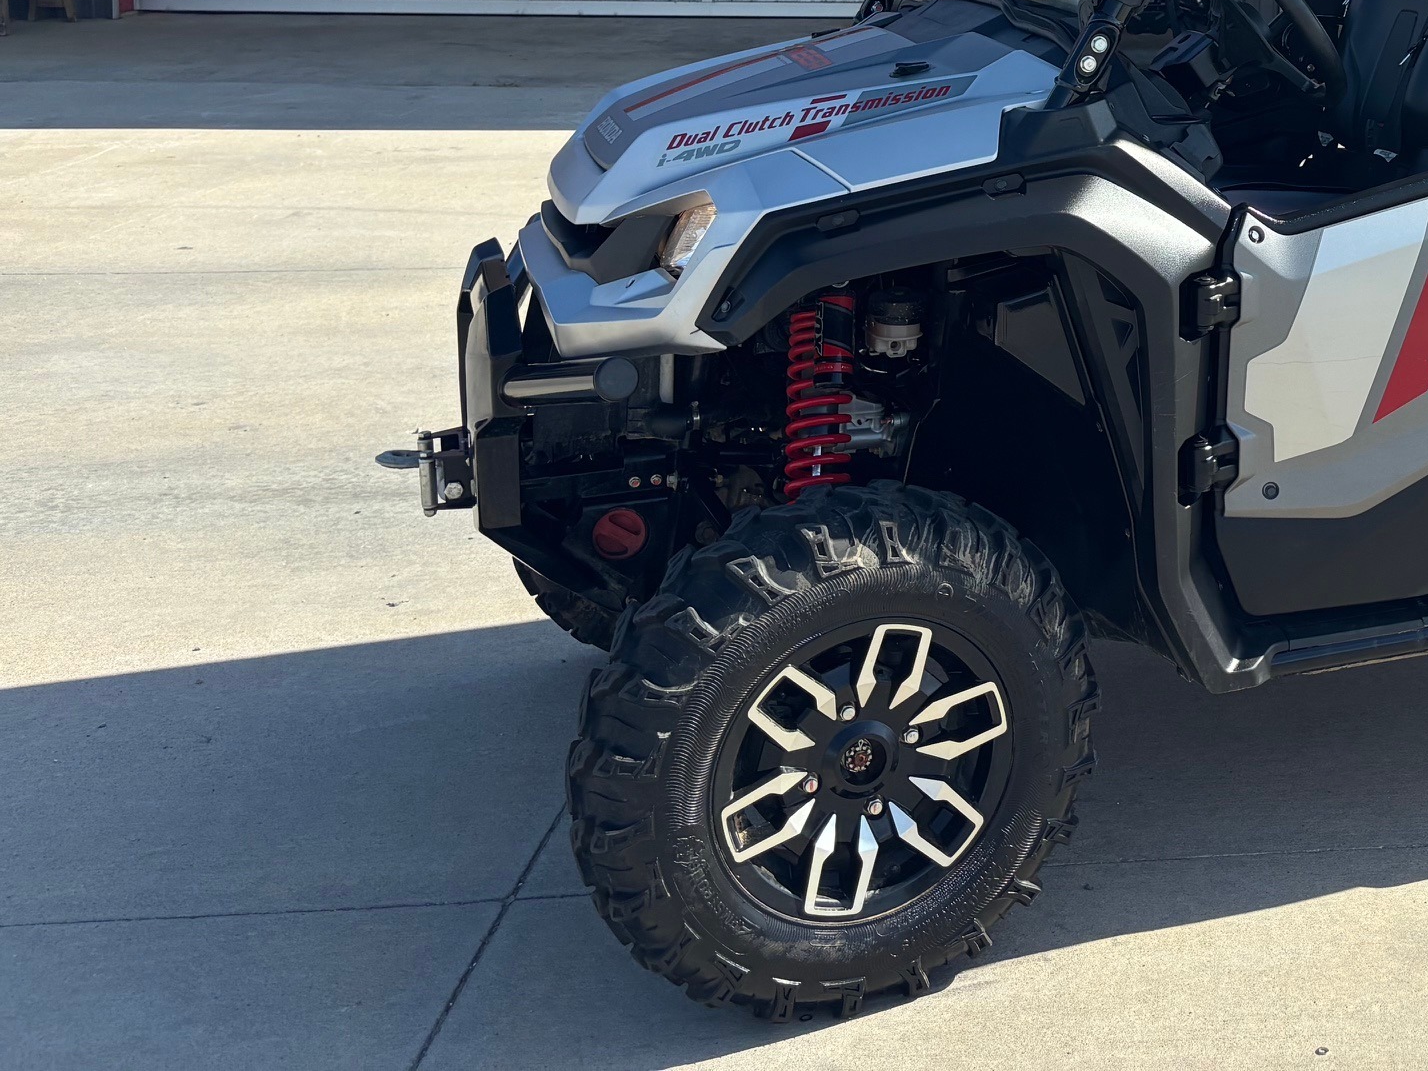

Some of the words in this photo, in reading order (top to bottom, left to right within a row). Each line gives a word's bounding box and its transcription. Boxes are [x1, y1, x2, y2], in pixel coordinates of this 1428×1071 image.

[666, 126, 721, 150] Dual
[722, 111, 795, 139] Clutch
[799, 85, 952, 124] Transmission
[656, 139, 742, 167] i-4WD
